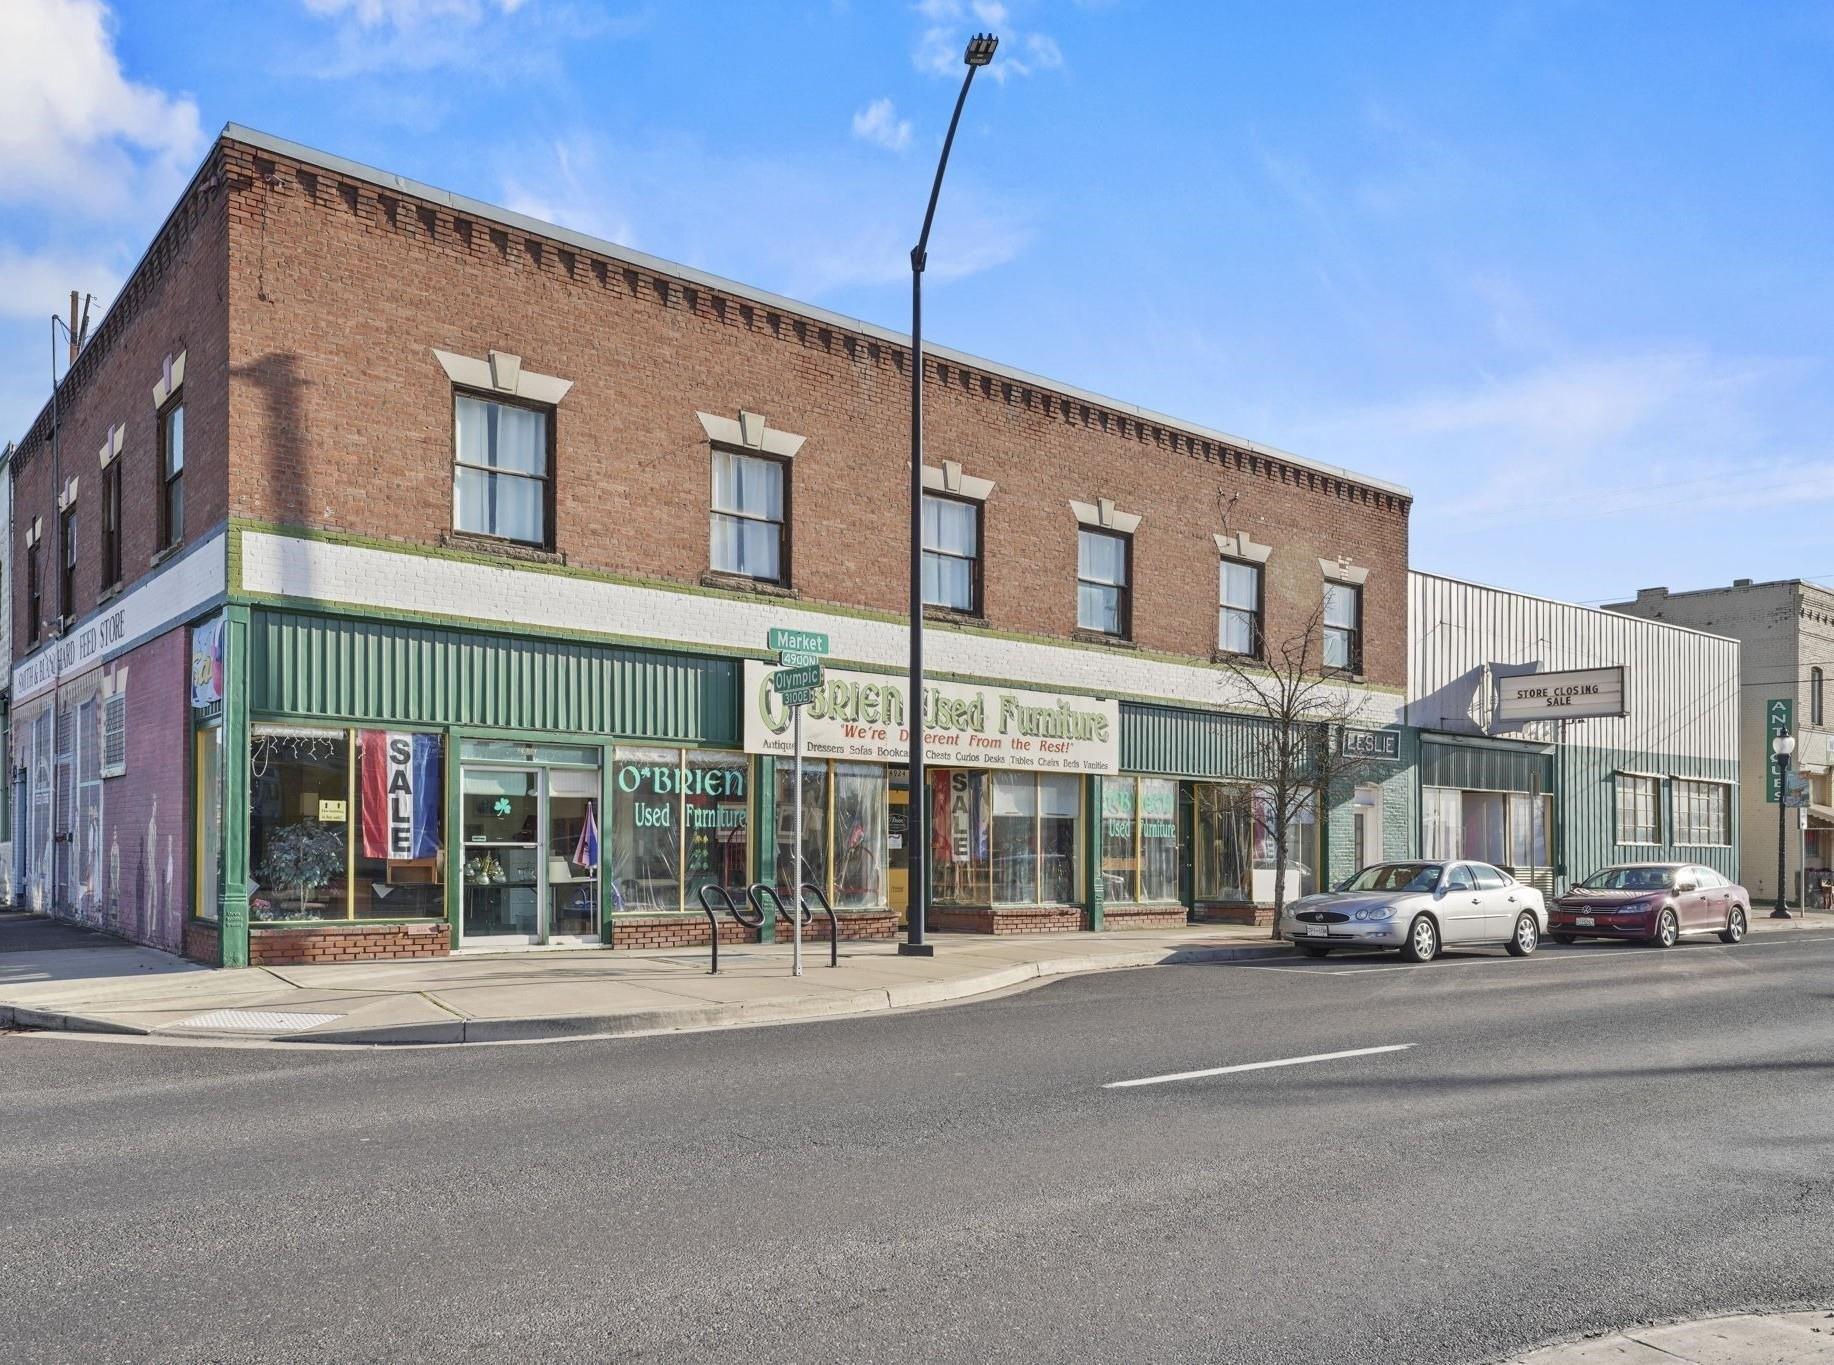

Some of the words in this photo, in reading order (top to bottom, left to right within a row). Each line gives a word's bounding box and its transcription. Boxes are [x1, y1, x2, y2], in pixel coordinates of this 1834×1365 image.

[40, 640, 75, 682] BLANHARD
[79, 627, 97, 660] FEED
[100, 609, 125, 648] STORE
[777, 631, 823, 651] Market
[784, 653, 816, 666] 4900N
[776, 668, 818, 689] Olympic
[785, 690, 808, 704] 3100E
[1517, 688, 1548, 699] STORE
[1554, 685, 1599, 697] CLOSING
[1546, 697, 1572, 707] SALE
[758, 670, 904, 736] OBRIEN
[923, 687, 985, 733] Used
[999, 694, 1110, 744] Furniture
[899, 728, 960, 746] Derent
[969, 734, 1002, 748] From
[1011, 738, 1031, 751] the
[1347, 734, 1395, 753] LESLIE
[807, 741, 845, 754] Dressers
[849, 745, 873, 756] Sofas
[877, 746, 911, 757] Bookca
[925, 750, 951, 761] Chests
[955, 751, 980, 762] Curios
[984, 753, 1006, 763] Desks
[1010, 755, 1034, 766] Tables
[1038, 757, 1060, 767] Chairs
[1063, 758, 1080, 769] Beds
[1083, 760, 1109, 770] Vanities
[388, 738, 413, 853] SALE
[634, 802, 670, 827] Used
[686, 803, 747, 828] Furniture
[952, 772, 969, 856] SALE
